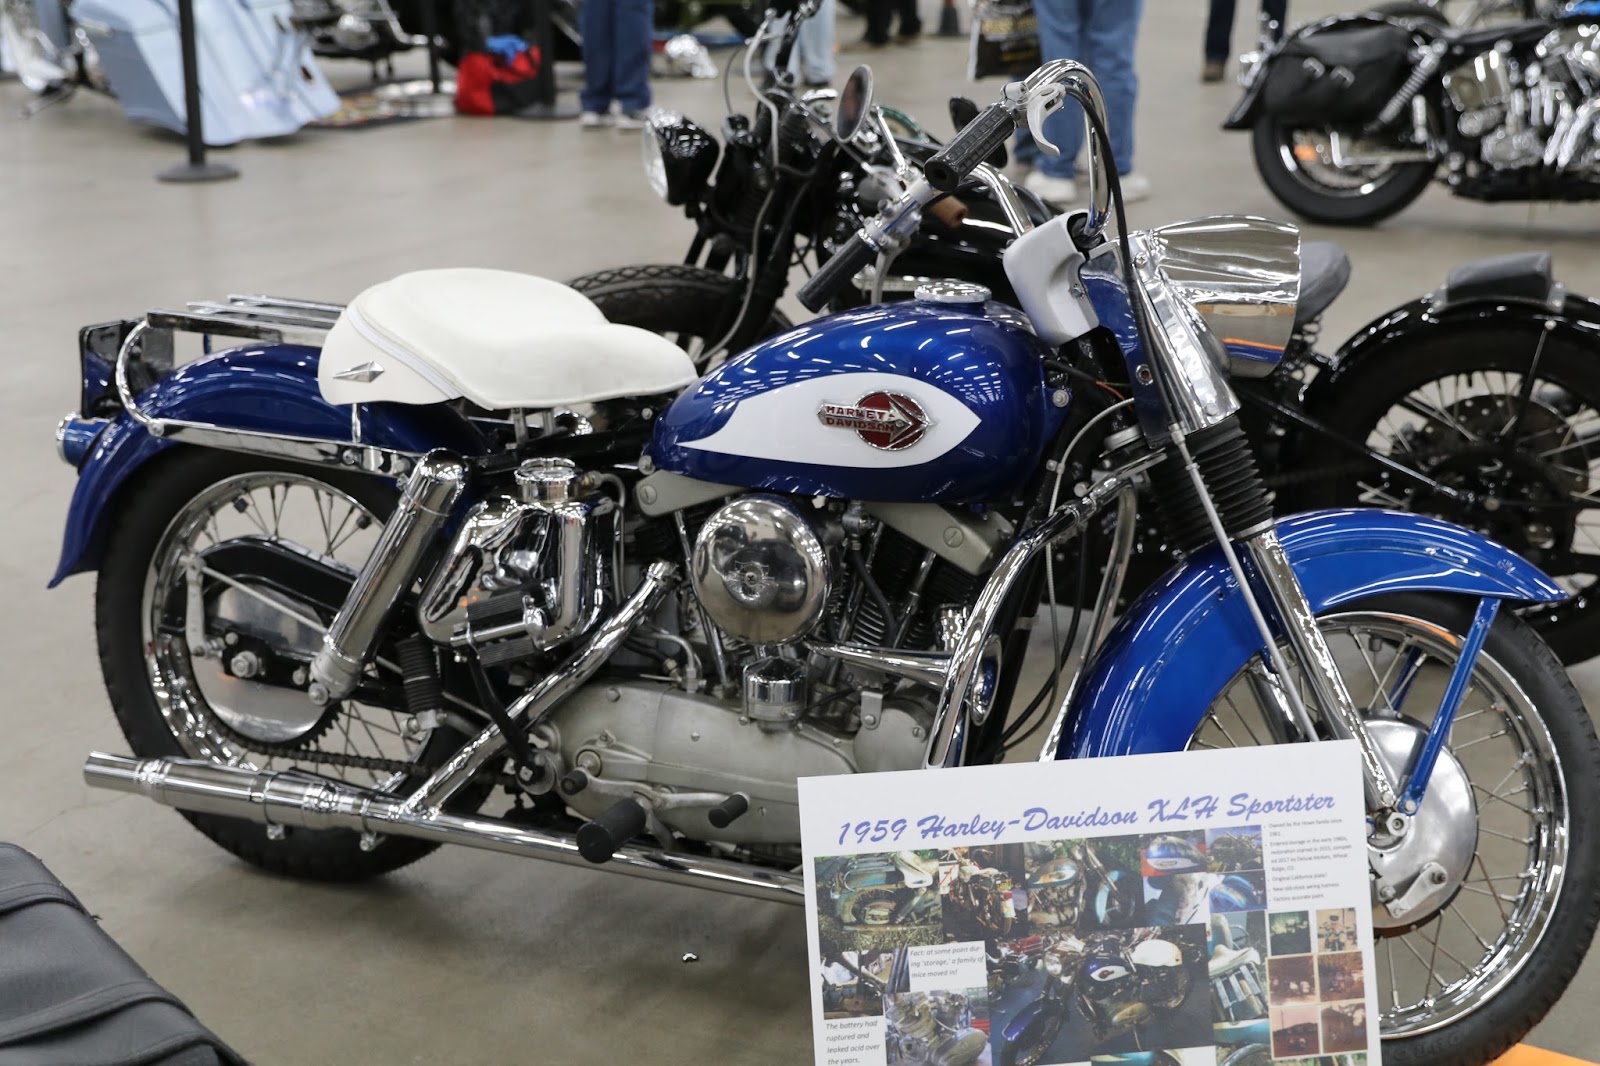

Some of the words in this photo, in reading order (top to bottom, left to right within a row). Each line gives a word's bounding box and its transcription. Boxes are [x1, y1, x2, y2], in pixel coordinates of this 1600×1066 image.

[825, 417, 895, 432] DAVIDSON
[838, 818, 907, 846] 1959
[917, 806, 1138, 841] Harley-Davidson
[1147, 794, 1219, 822] XLH
[1226, 792, 1335, 821] Sportster
[956, 957, 976, 965] family
[826, 1033, 856, 1042] ruptured
